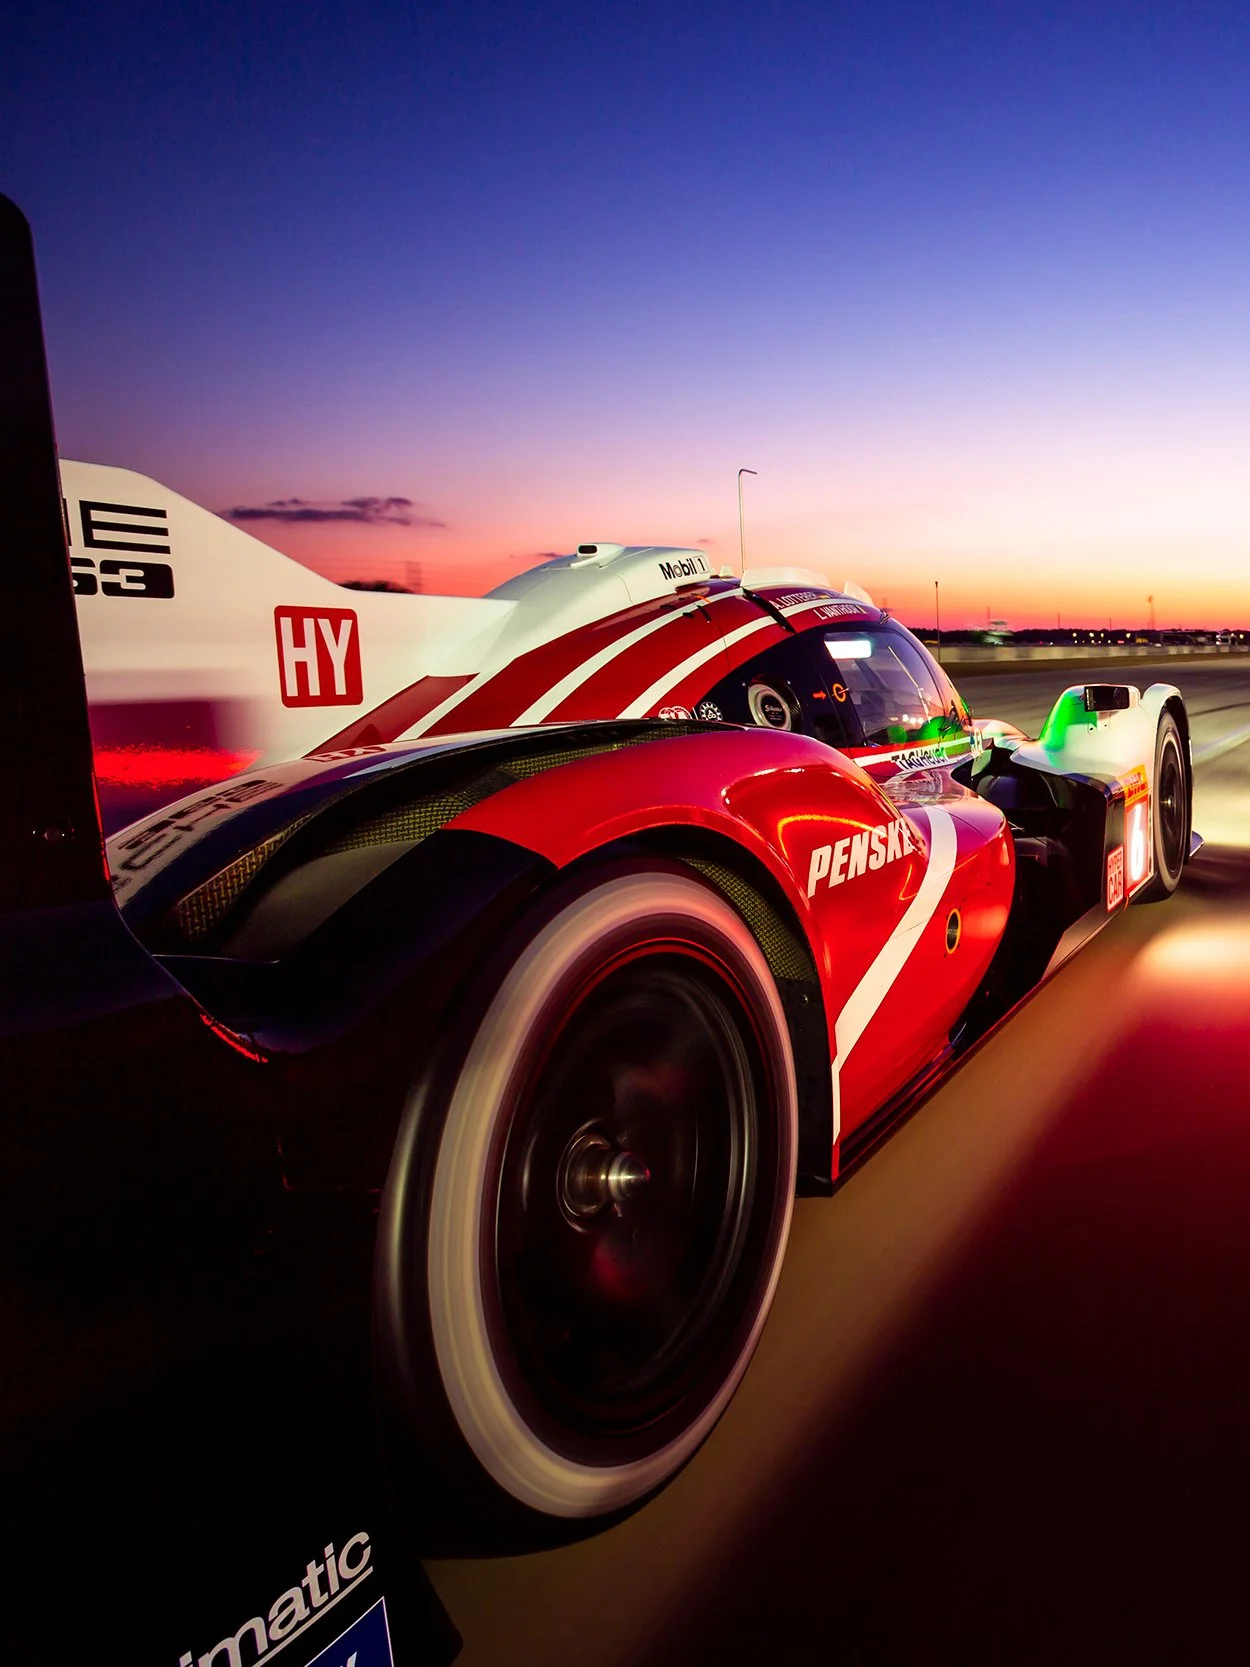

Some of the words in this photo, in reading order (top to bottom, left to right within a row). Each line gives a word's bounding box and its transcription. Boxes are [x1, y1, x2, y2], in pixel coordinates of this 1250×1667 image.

[658, 558, 698, 580] Mobil
[697, 557, 706, 572] 1
[279, 617, 353, 697] HY
[807, 818, 917, 898] PENSKE
[1131, 802, 1144, 881] 6
[1108, 869, 1122, 905] CAR
